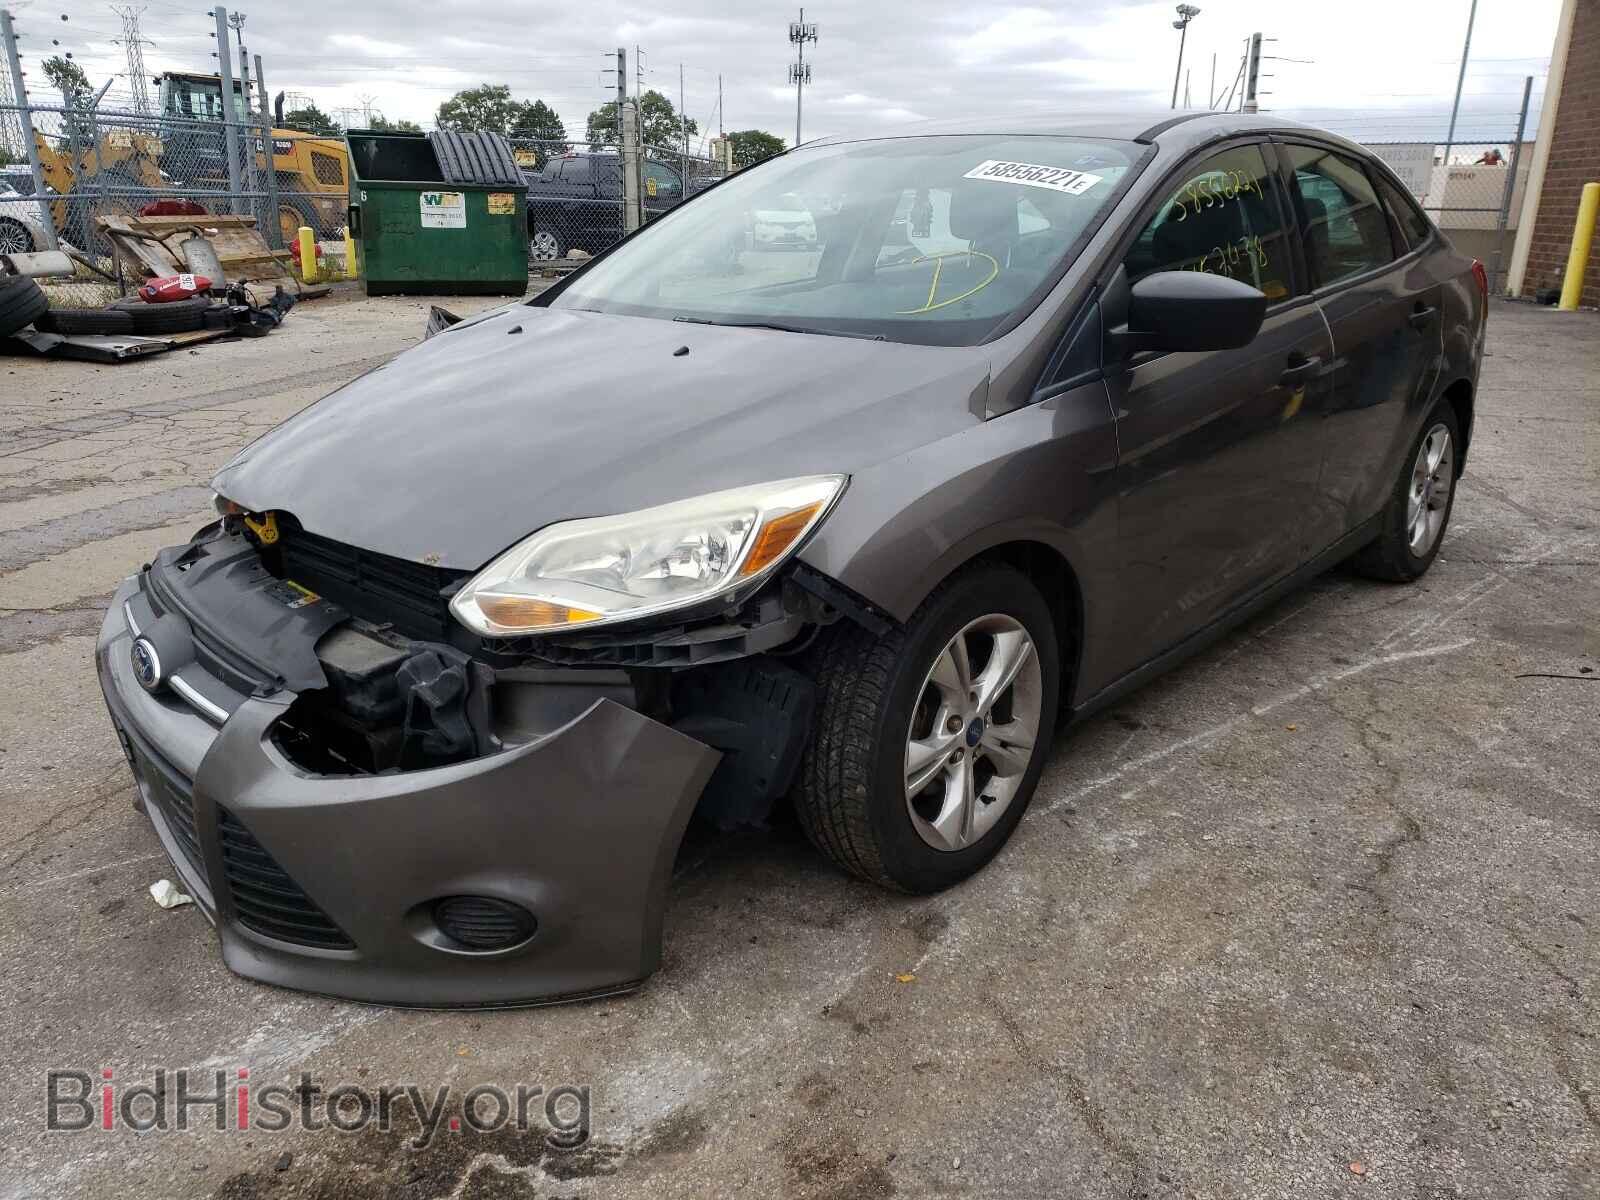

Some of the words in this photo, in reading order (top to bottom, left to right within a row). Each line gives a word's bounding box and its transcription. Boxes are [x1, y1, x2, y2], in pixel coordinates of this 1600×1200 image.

[984, 162, 1083, 187] 58556221
[1073, 180, 1087, 190] E
[360, 190, 367, 201] 6
